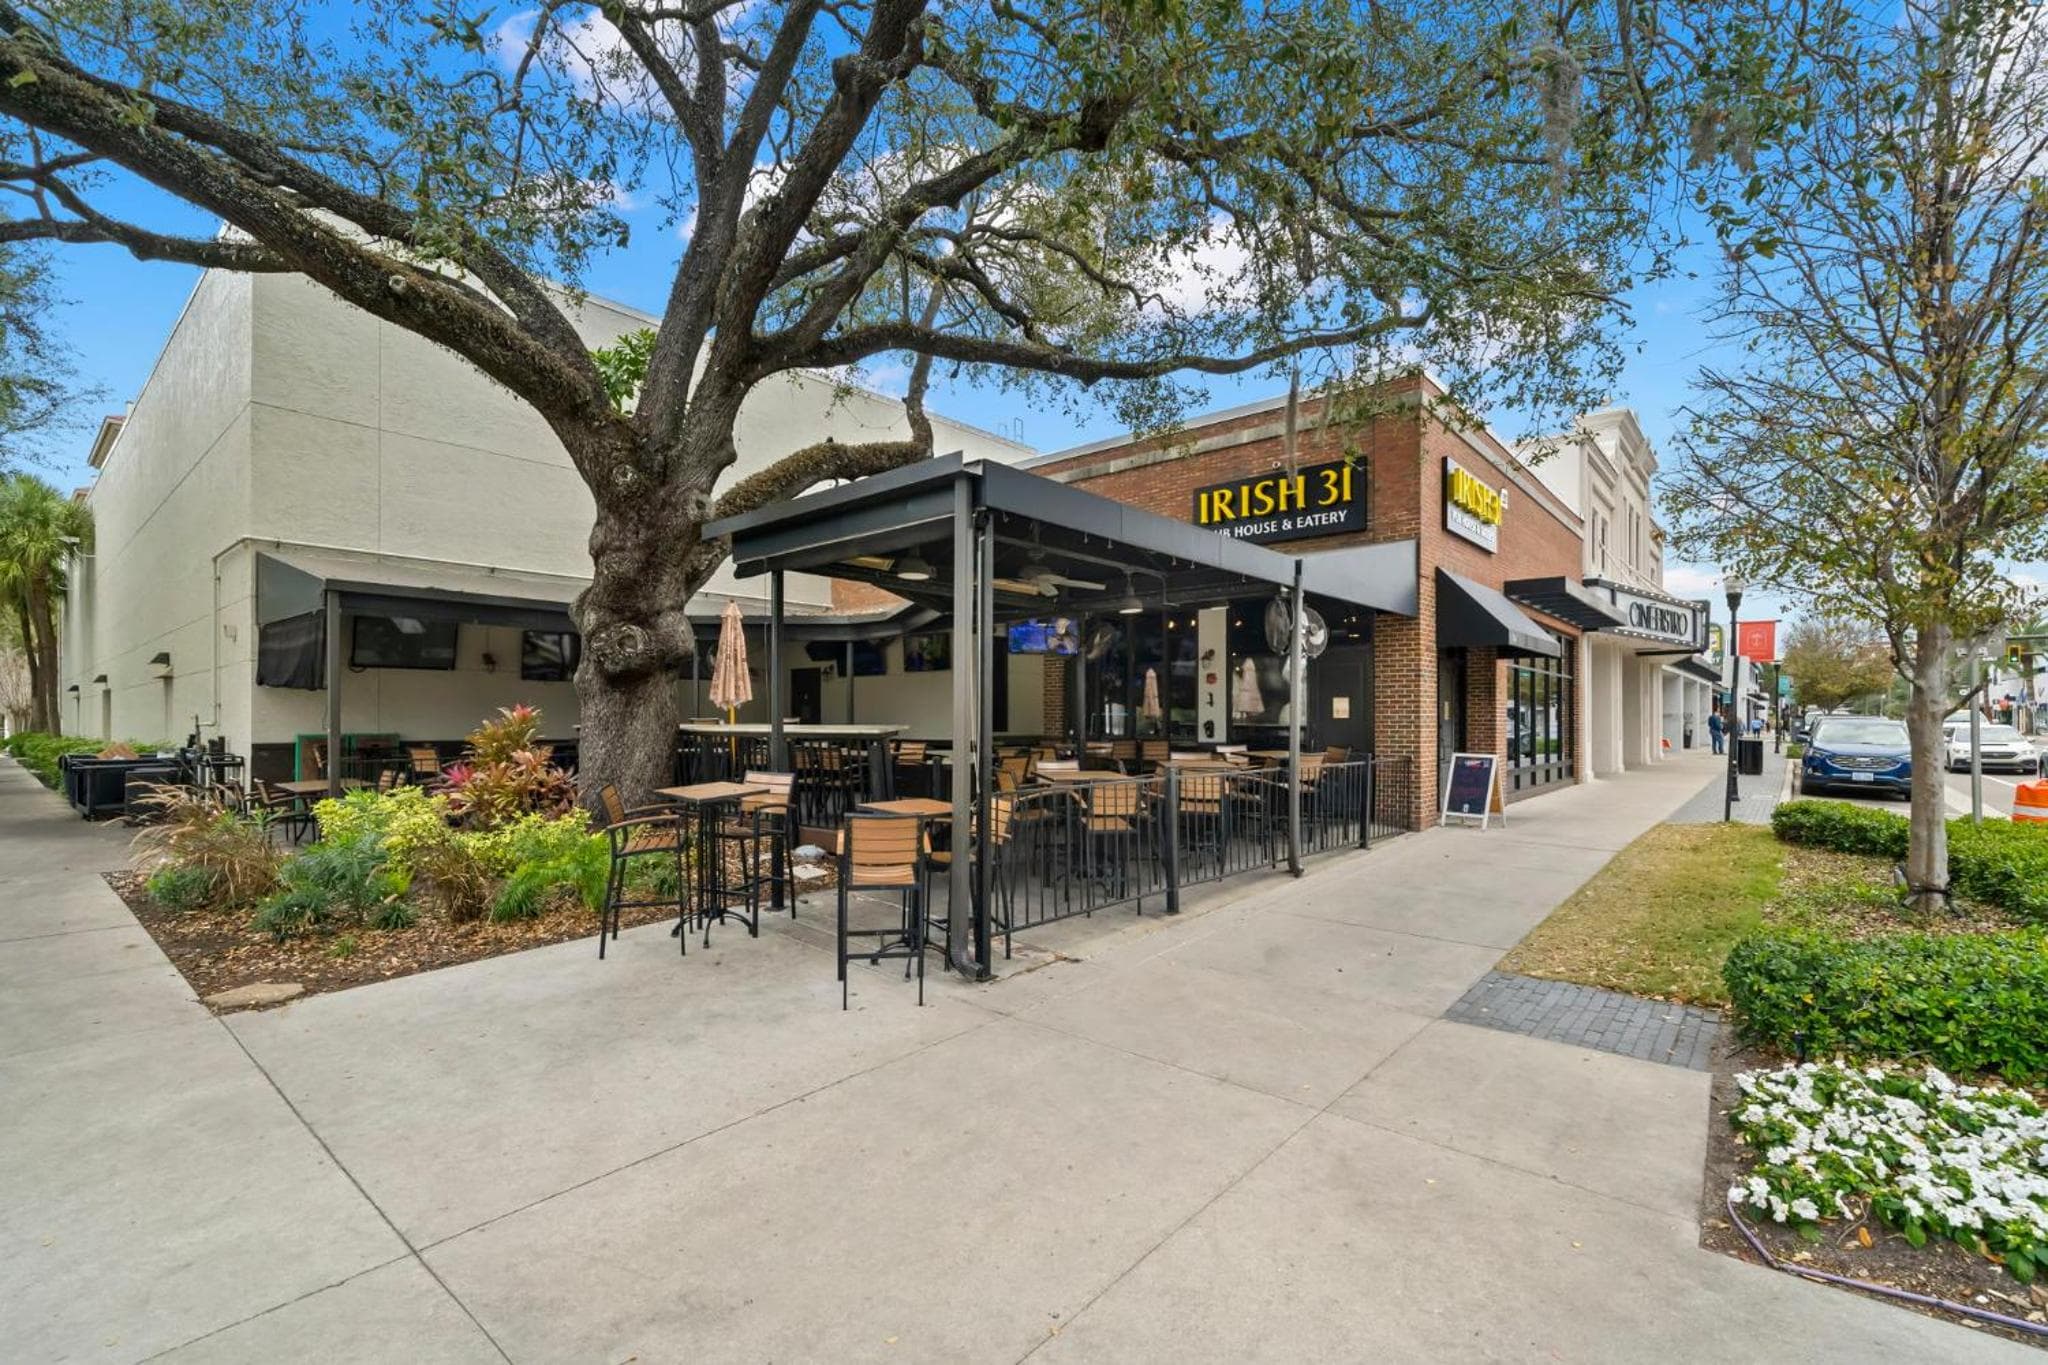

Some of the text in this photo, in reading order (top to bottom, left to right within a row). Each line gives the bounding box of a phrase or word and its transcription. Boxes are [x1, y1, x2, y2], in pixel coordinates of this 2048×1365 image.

[1200, 466, 1352, 524] IRISH 31
[1234, 520, 1278, 538] HOUSE
[1281, 518, 1293, 531] &
[1296, 509, 1349, 529] EATERY
